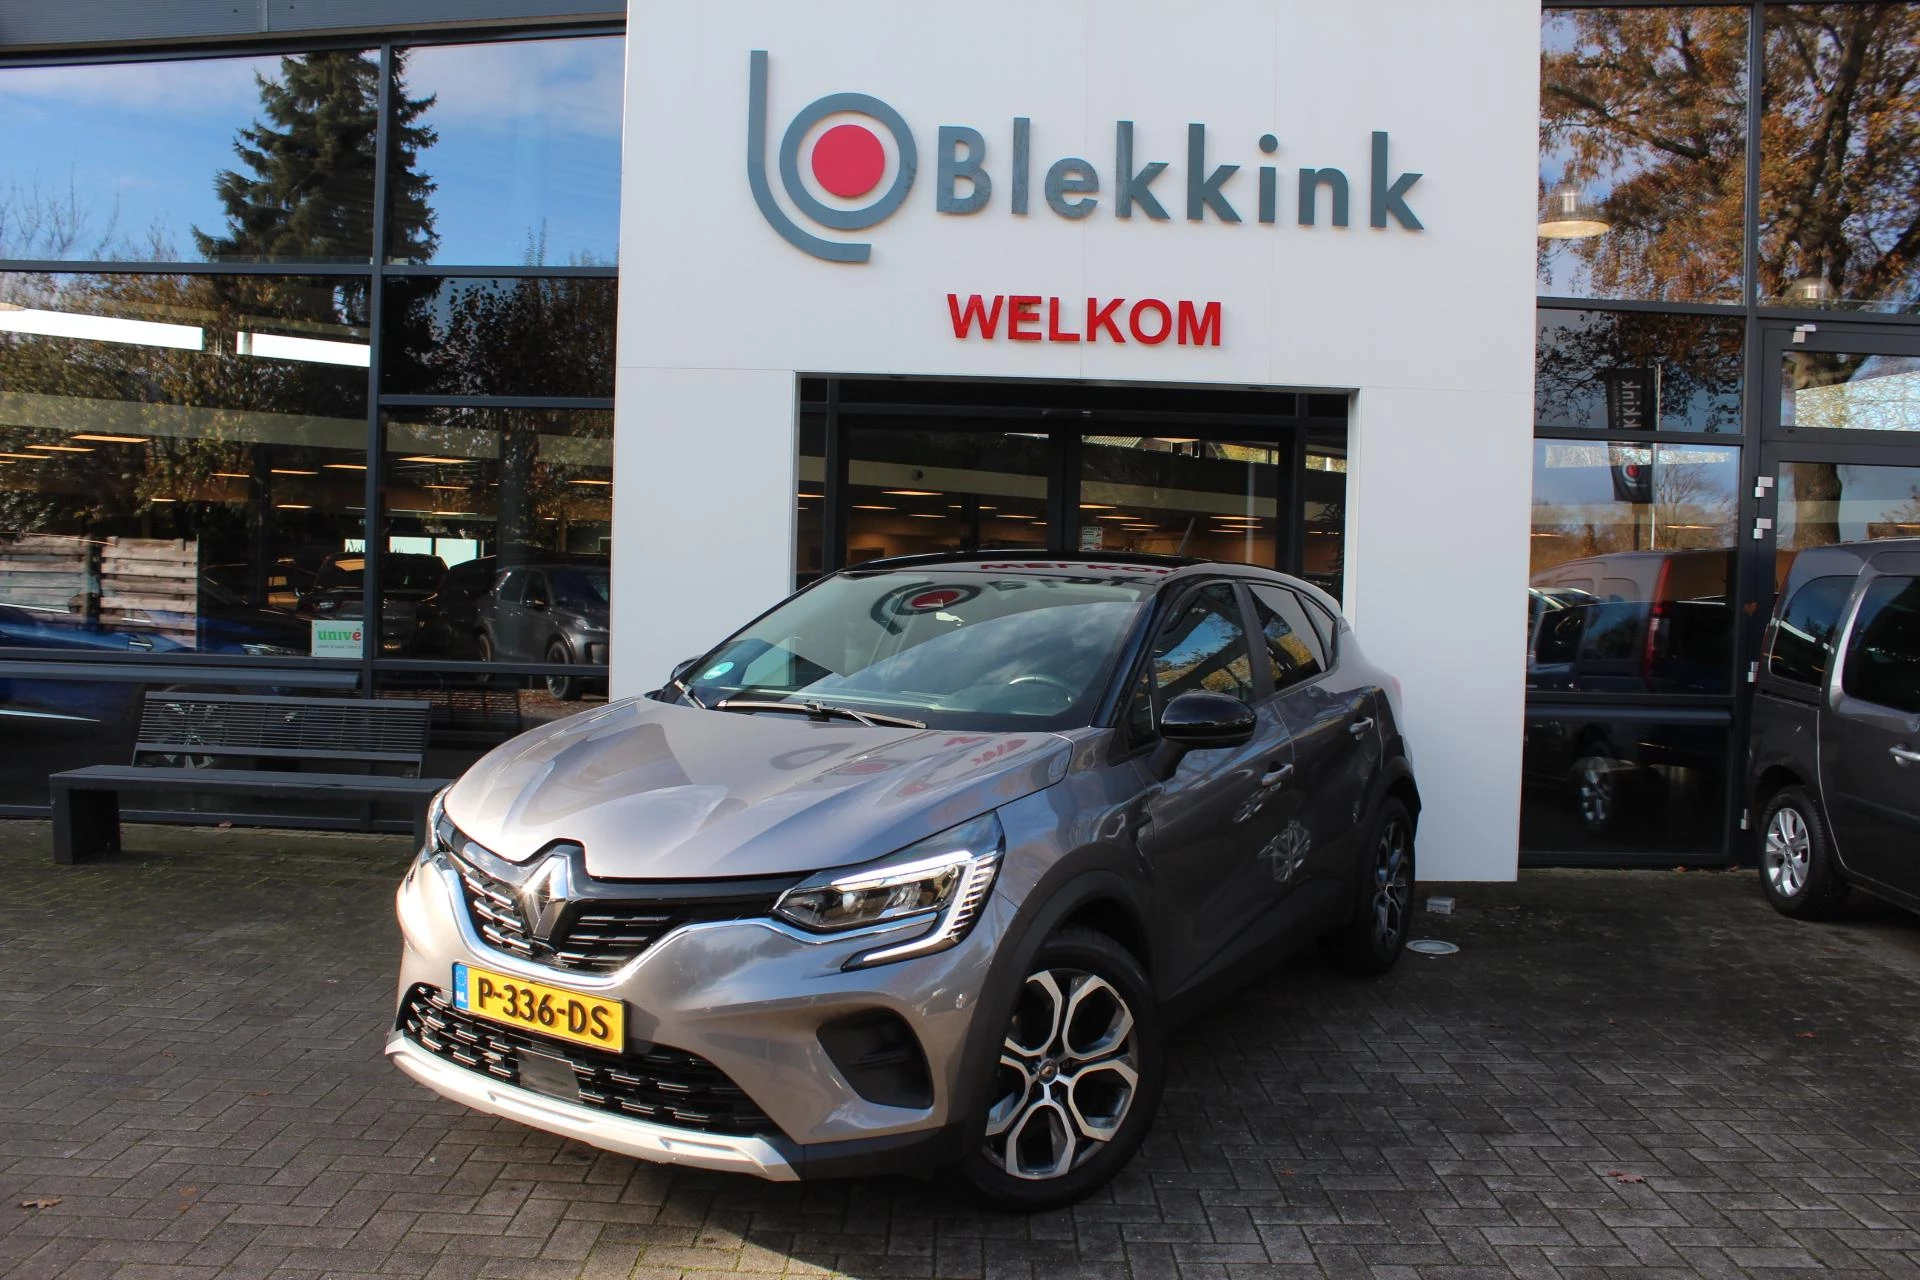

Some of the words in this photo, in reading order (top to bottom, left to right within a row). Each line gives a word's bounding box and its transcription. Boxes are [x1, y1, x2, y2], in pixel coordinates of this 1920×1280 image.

[936, 117, 1425, 230] Blekkink
[947, 293, 1222, 346] WELKOM
[456, 990, 467, 1002] NL
[478, 977, 609, 1040] P-336-DS
